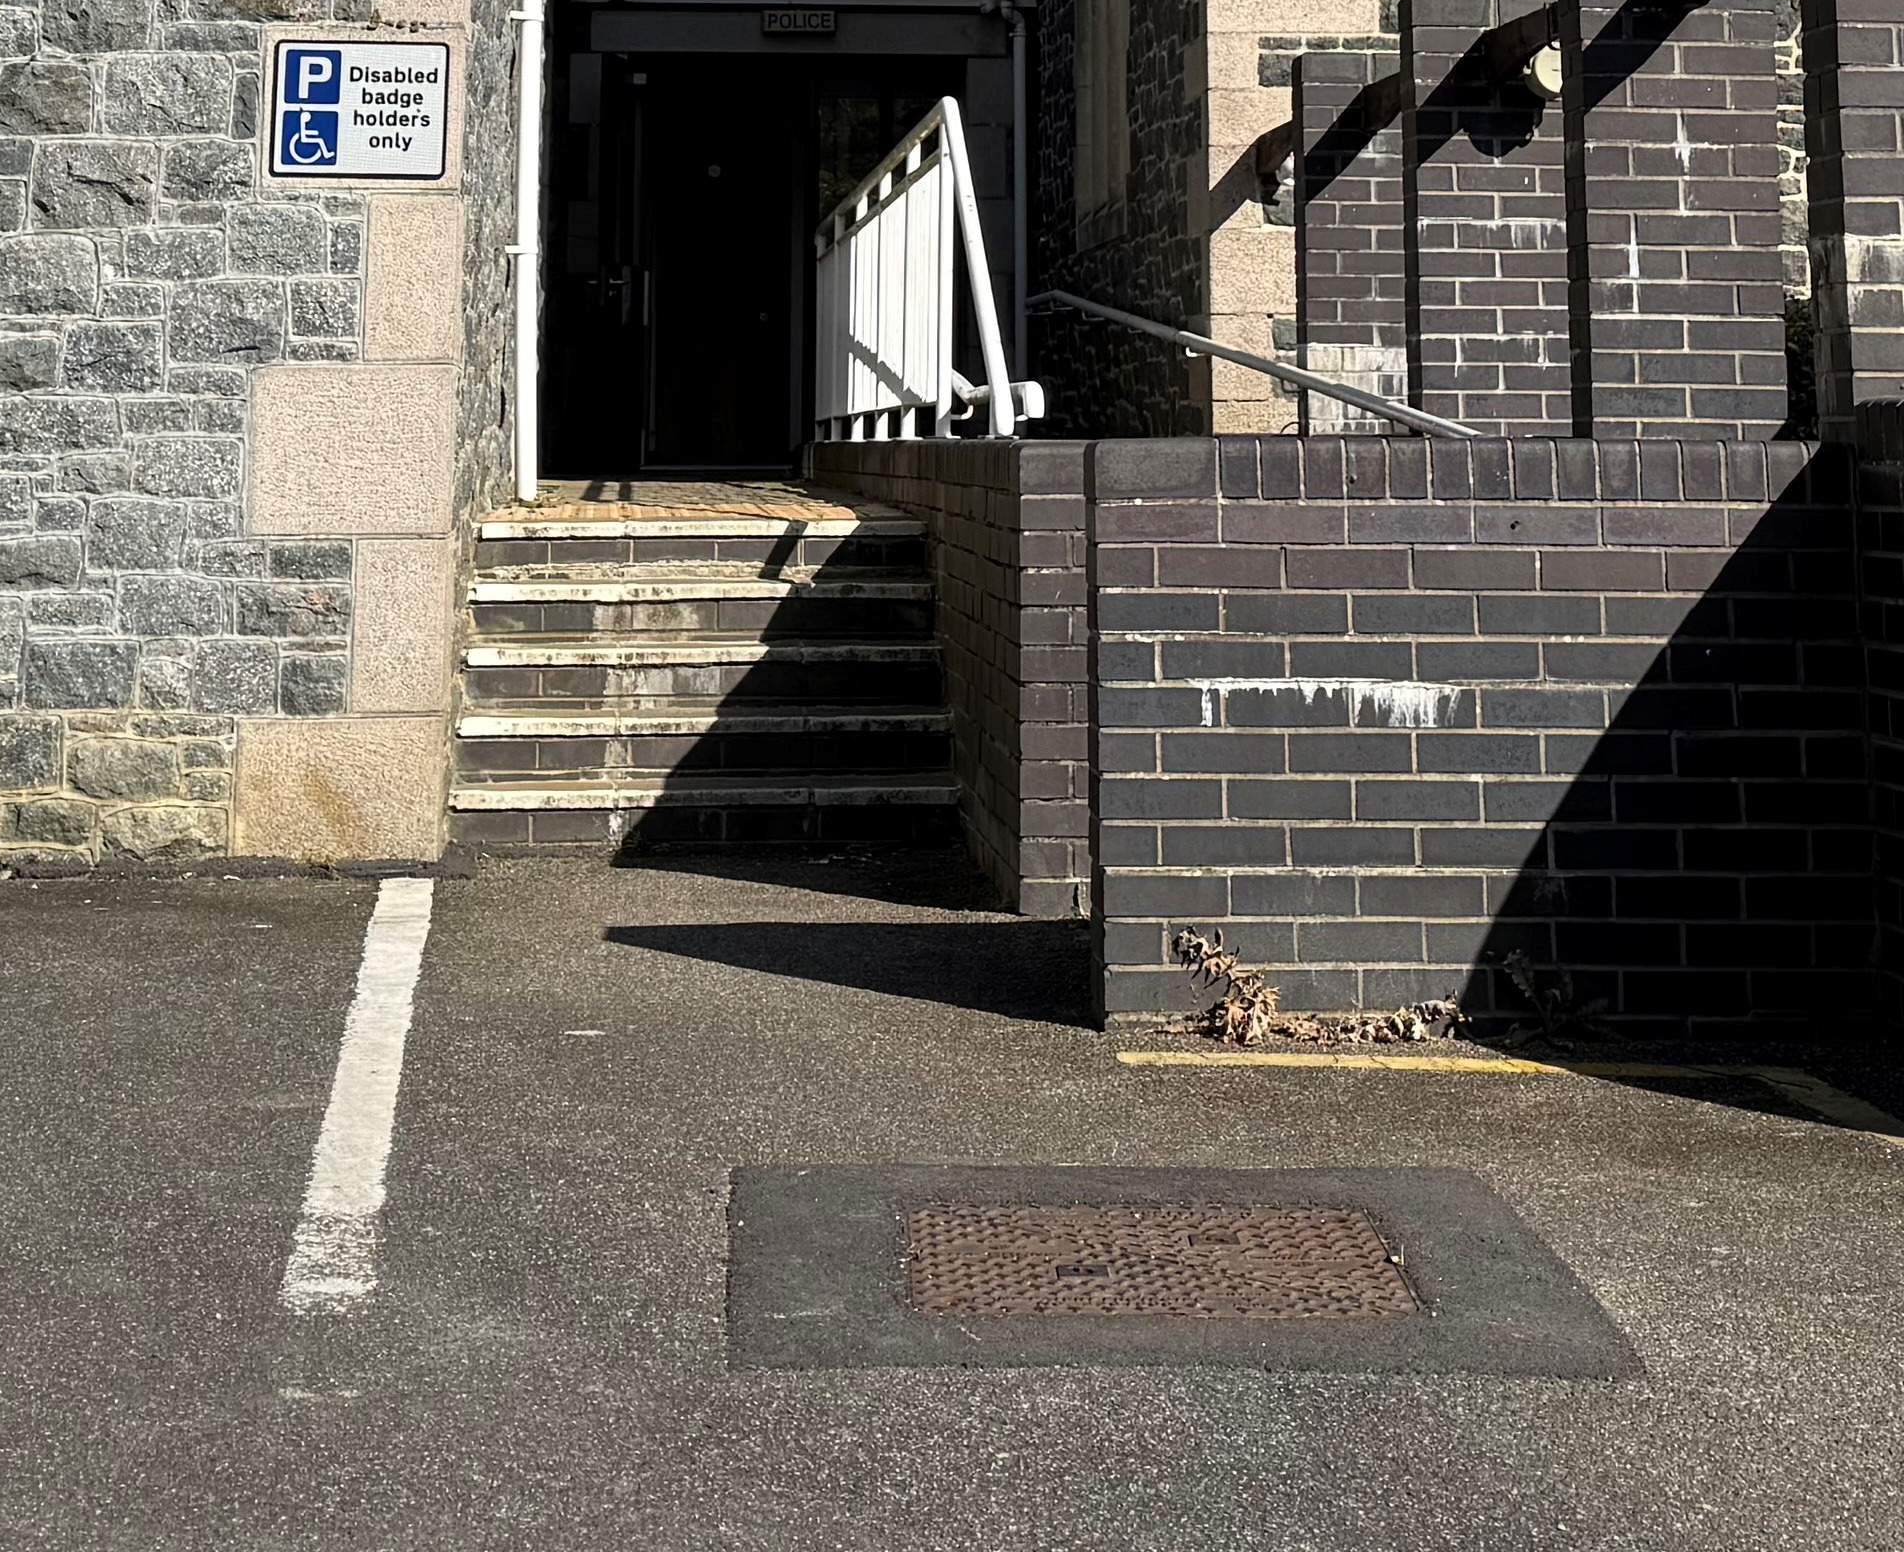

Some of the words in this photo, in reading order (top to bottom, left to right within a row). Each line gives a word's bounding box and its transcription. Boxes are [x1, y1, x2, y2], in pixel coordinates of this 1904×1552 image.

[767, 13, 831, 29] POLICE
[298, 56, 333, 99] P
[349, 66, 439, 84] Disabled
[362, 88, 424, 108] badge
[353, 110, 431, 127] holders
[369, 132, 413, 152] only
